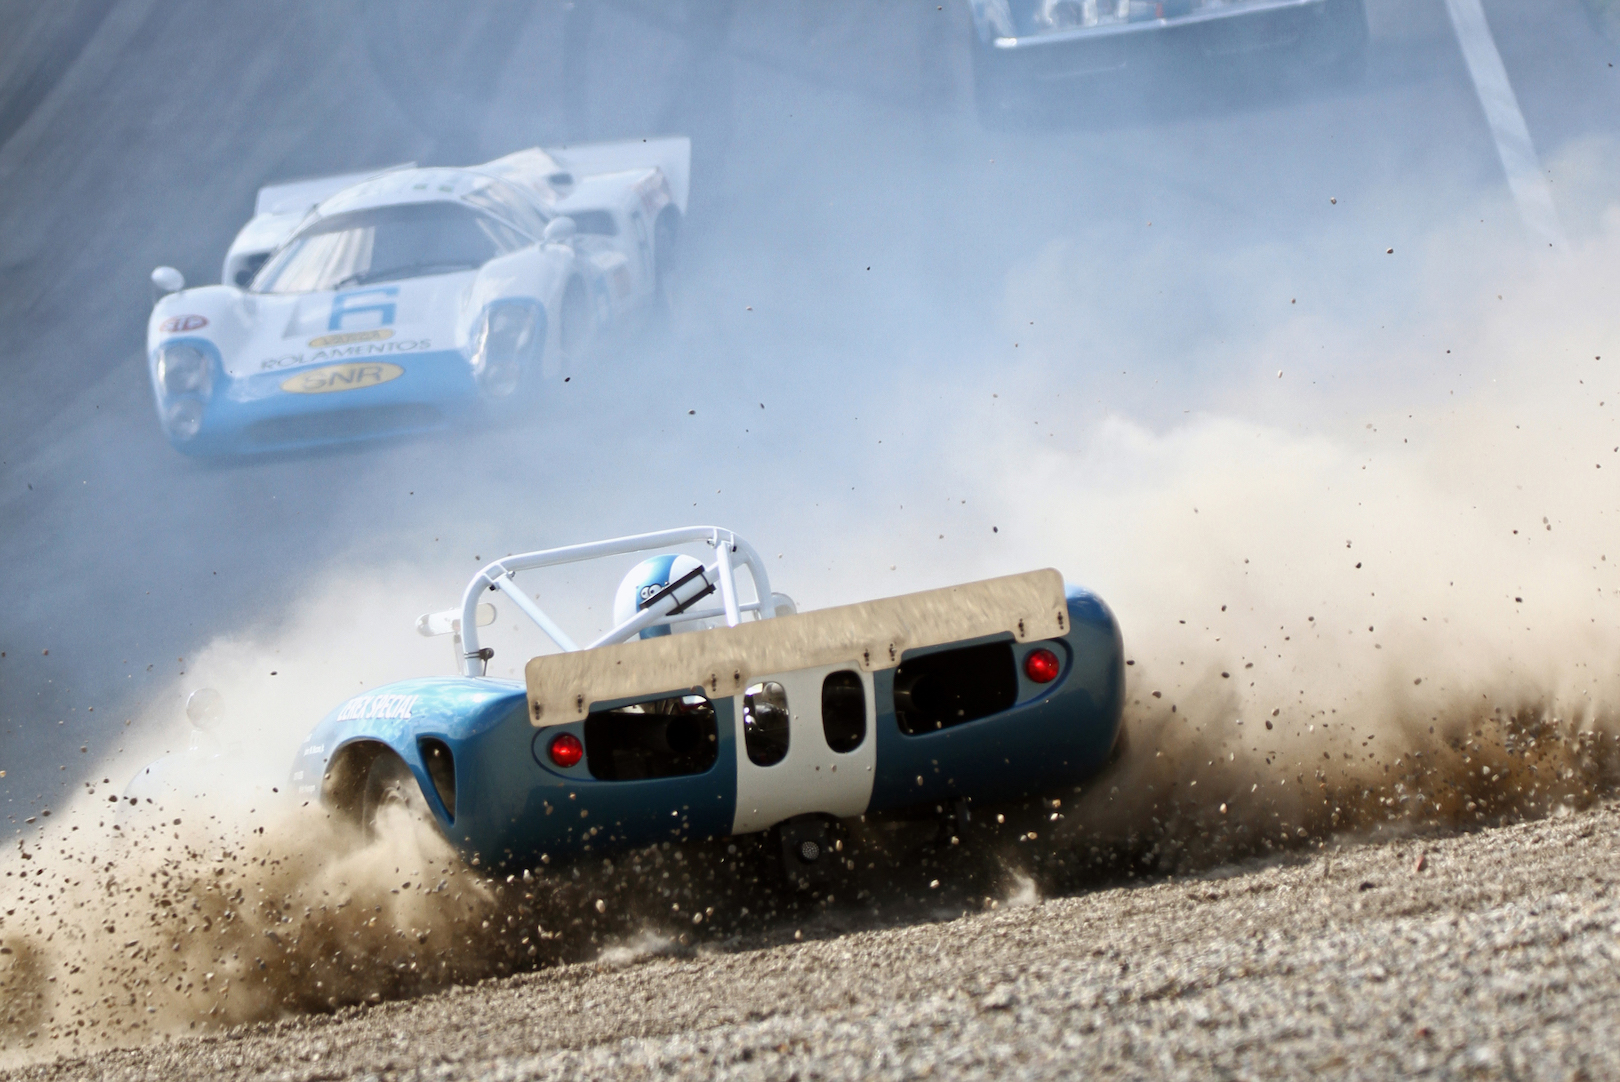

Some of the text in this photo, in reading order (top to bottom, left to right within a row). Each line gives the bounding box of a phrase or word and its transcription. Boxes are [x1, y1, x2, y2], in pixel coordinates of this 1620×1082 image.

[260, 339, 432, 370] ROLAMENTOS
[302, 365, 384, 390] SNR
[365, 694, 419, 720] SPECIAL
